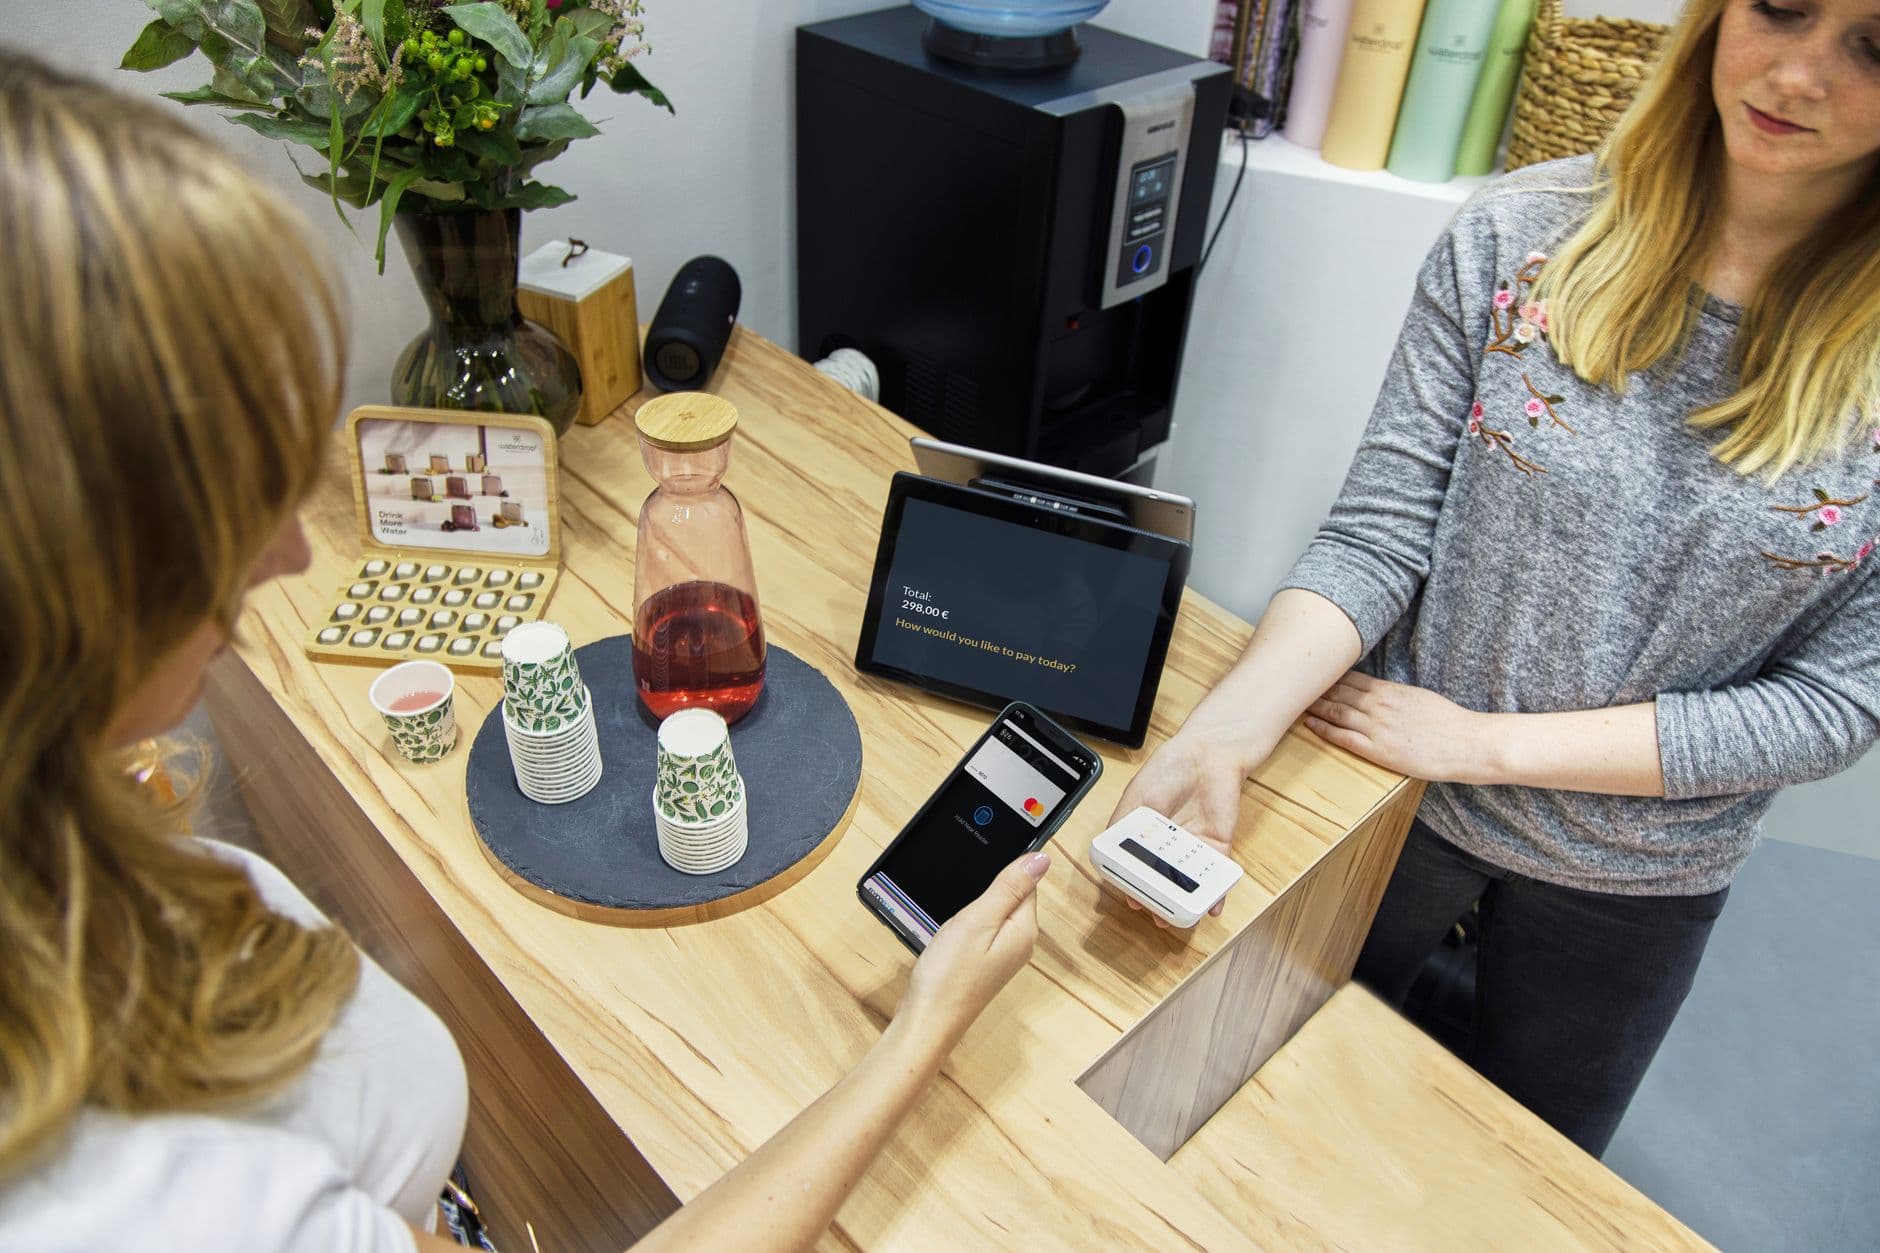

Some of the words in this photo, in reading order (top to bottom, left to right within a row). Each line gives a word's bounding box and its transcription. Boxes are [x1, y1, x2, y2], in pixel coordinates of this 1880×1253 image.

[378, 510, 404, 520] Drink
[379, 519, 403, 527] More
[380, 526, 408, 535] Water
[902, 585, 932, 602] Total:
[941, 610, 950, 620] €
[895, 617, 921, 632] How
[923, 626, 957, 642] would
[958, 633, 978, 648] you
[980, 639, 1001, 653] like
[1002, 646, 1014, 657] to
[1015, 651, 1036, 664] pay
[1038, 655, 1077, 673] today?
